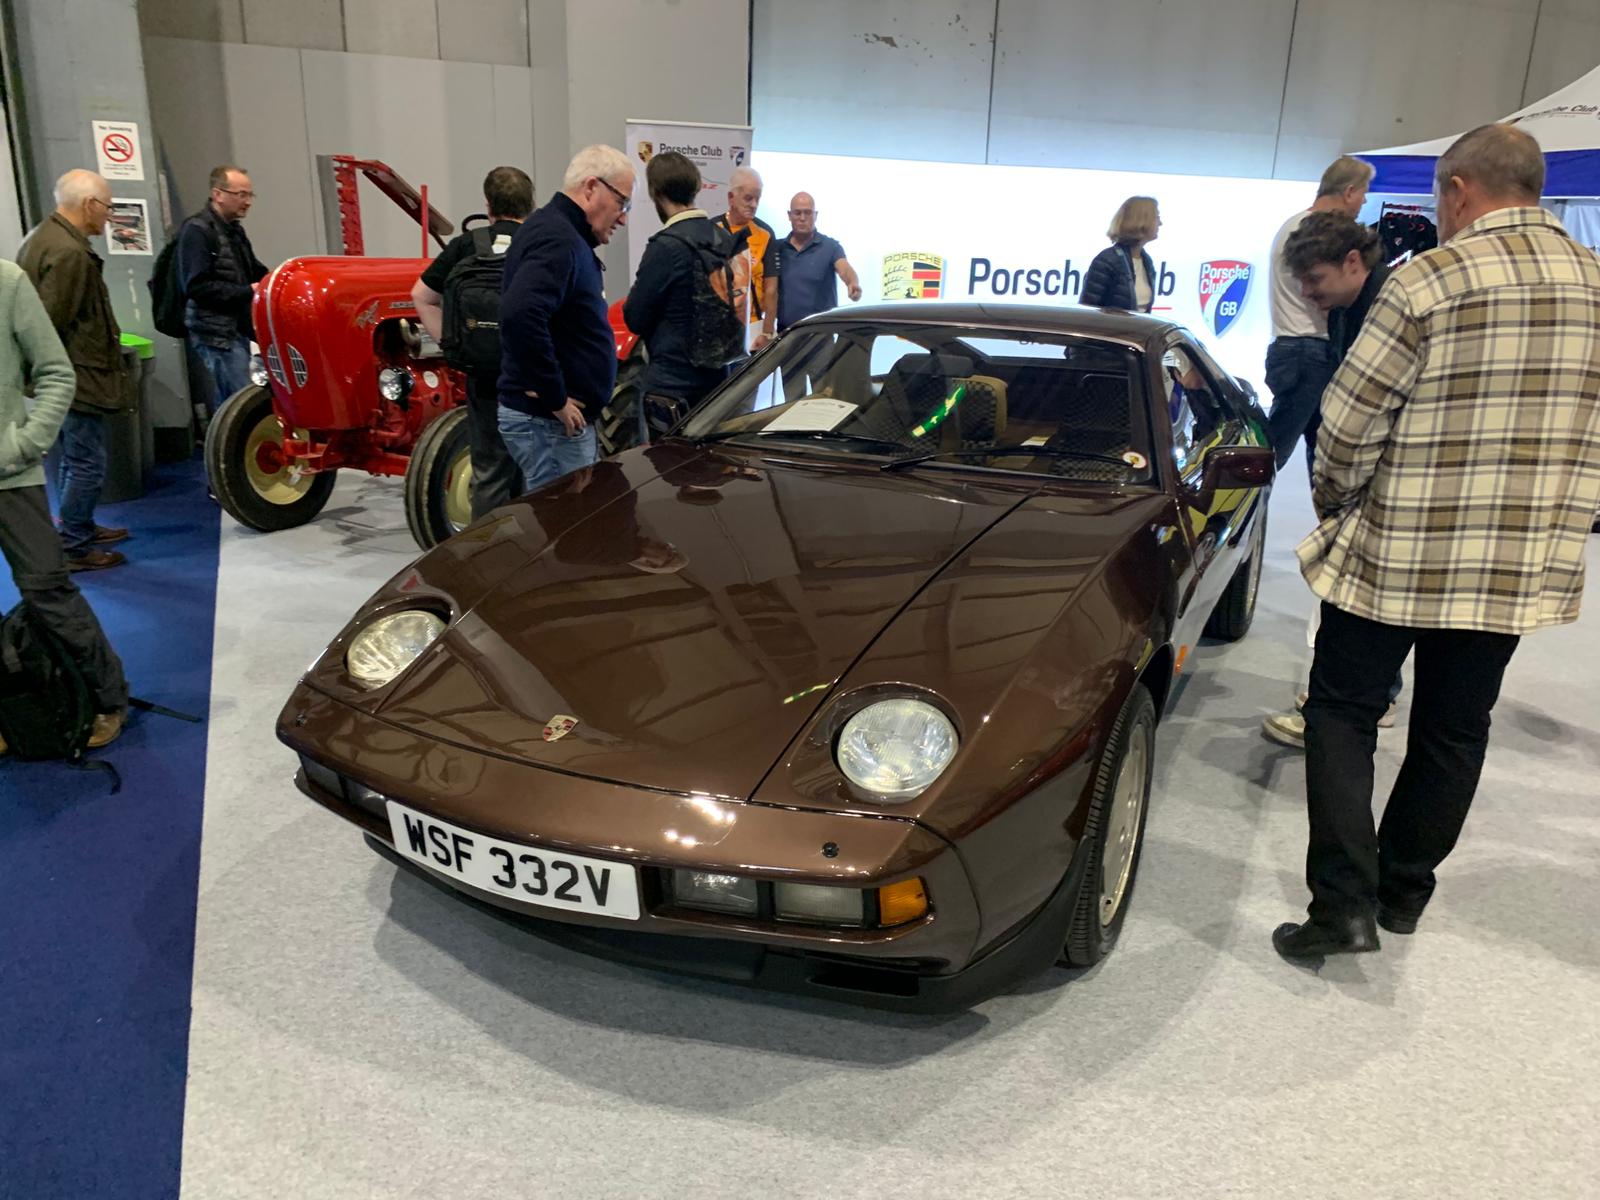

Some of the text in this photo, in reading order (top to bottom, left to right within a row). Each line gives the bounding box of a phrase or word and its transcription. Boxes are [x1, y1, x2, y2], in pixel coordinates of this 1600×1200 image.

[700, 145, 722, 156] Club
[884, 252, 942, 266] PORSCHE
[968, 258, 1087, 296] Porsch
[1201, 264, 1249, 279] Porsche
[1200, 280, 1226, 295] Clu
[1220, 301, 1238, 316] GB
[403, 813, 611, 907] WSF 332V
